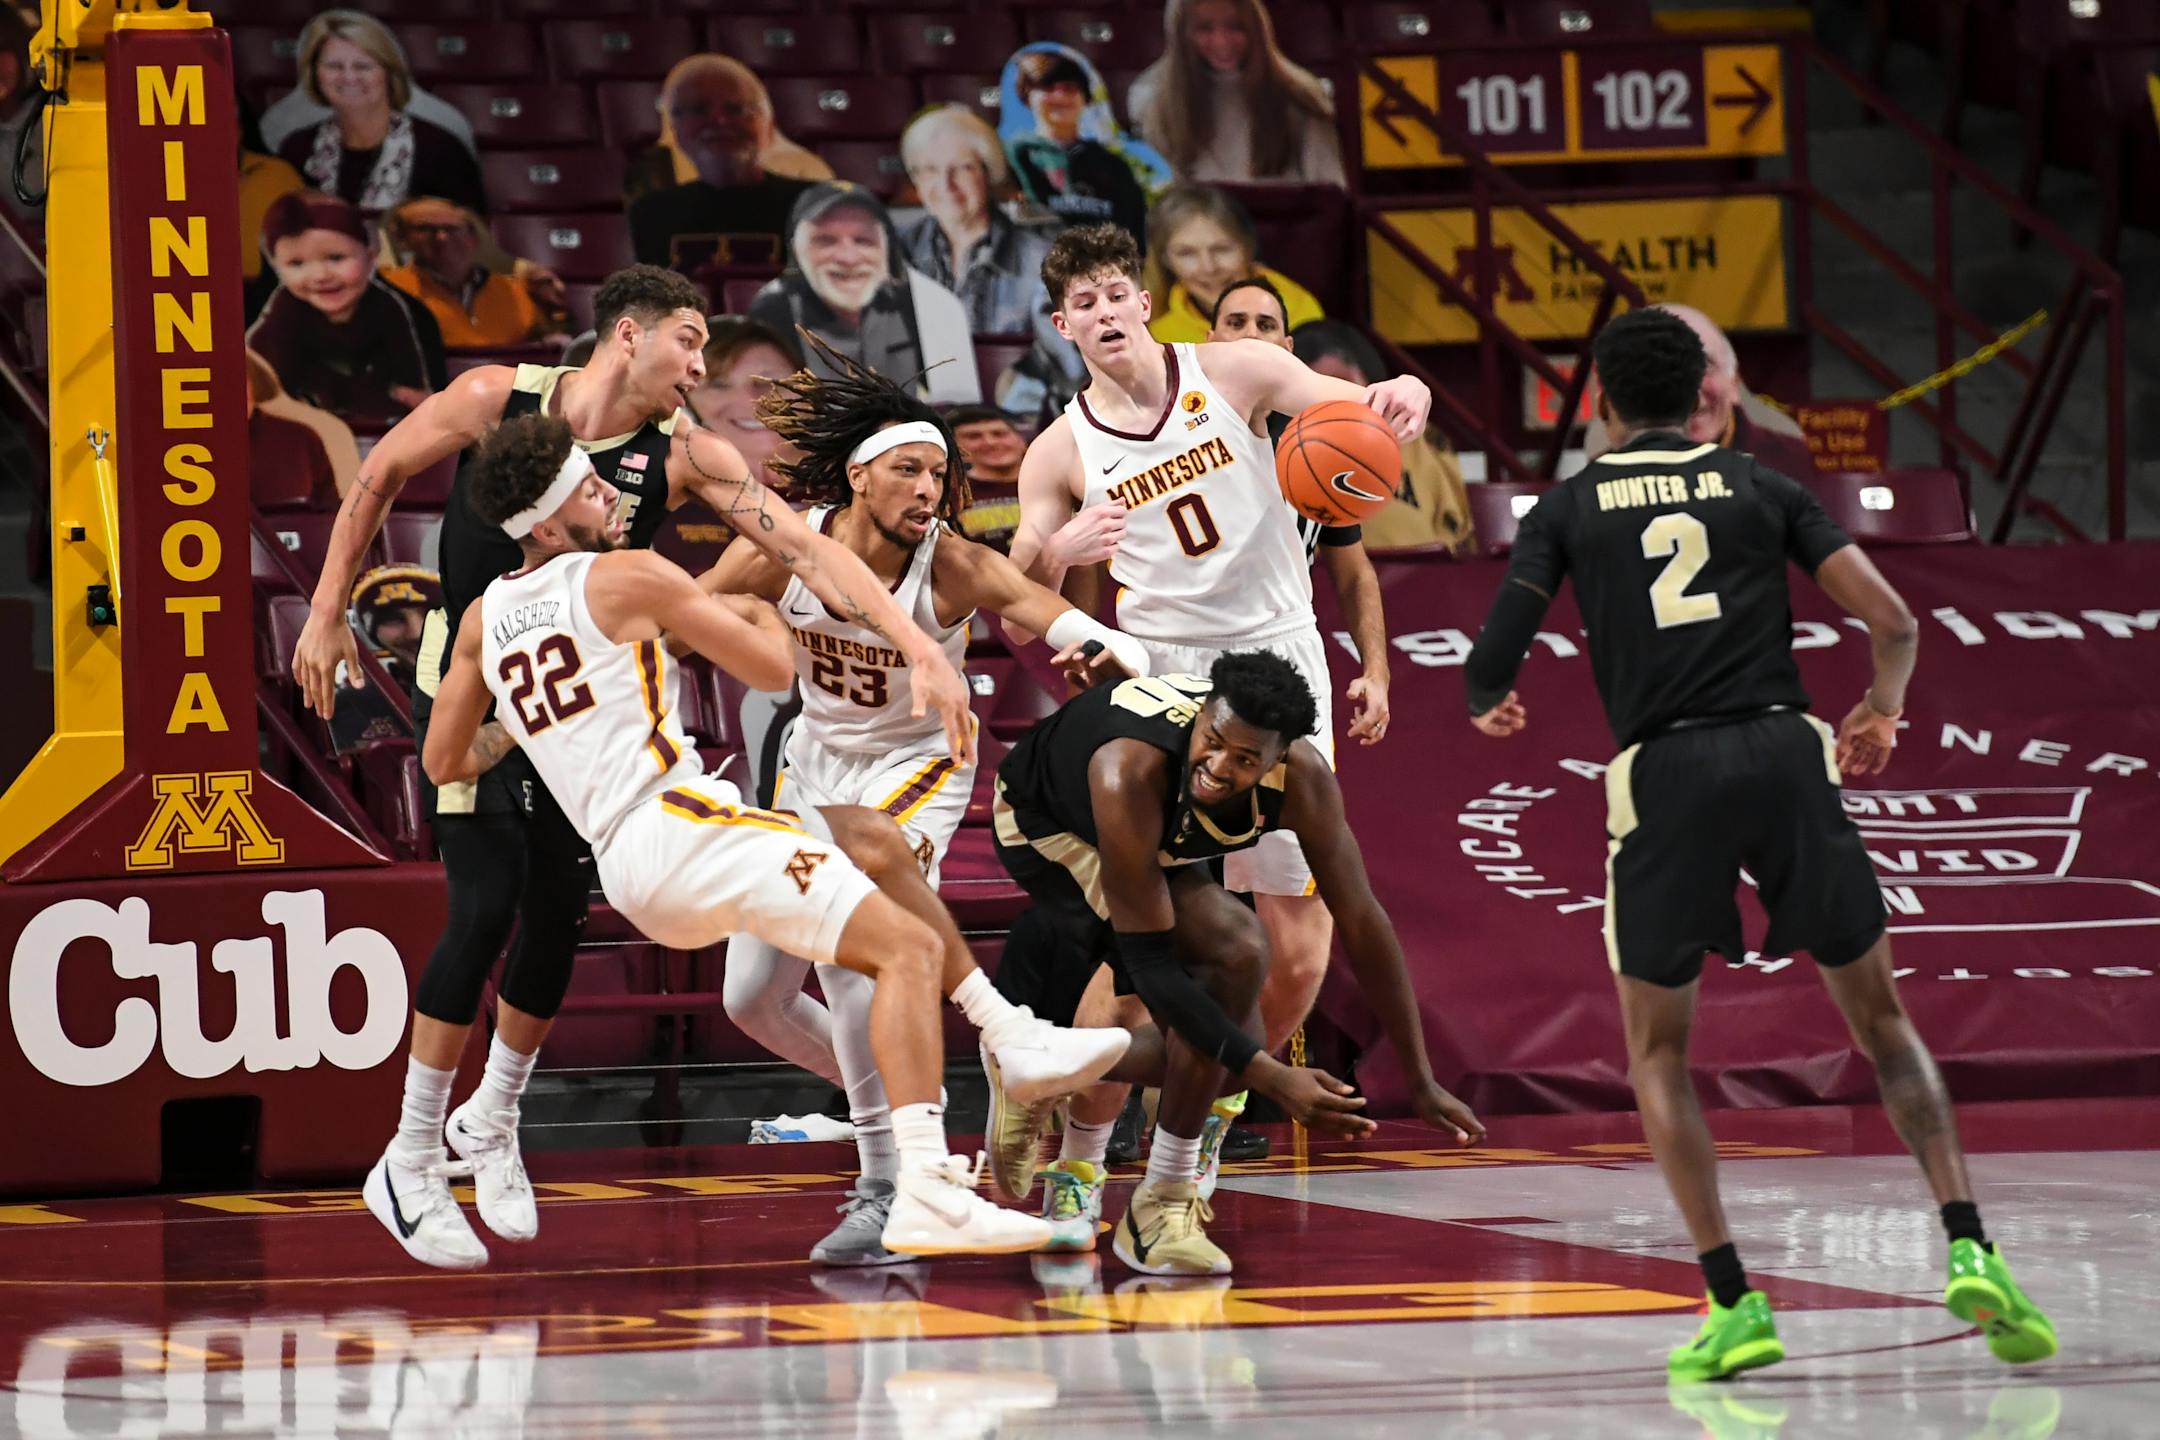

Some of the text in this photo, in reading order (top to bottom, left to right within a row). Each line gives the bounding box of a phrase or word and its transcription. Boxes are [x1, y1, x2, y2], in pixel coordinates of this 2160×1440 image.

[1456, 75, 1546, 135] 101
[1593, 70, 1692, 130] 102
[136, 65, 230, 734] MINNESOTA
[1106, 437, 1234, 511] MINNESOTA
[1596, 471, 1734, 511] HUNTER JR.
[1166, 492, 1221, 557] 0
[1640, 512, 1722, 630] 2
[492, 600, 560, 650] KALSCHEUR
[498, 633, 597, 736] 22
[809, 648, 889, 708] 23
[9, 888, 409, 1087] Cub
[178, 1142, 1827, 1213] GOPERS
